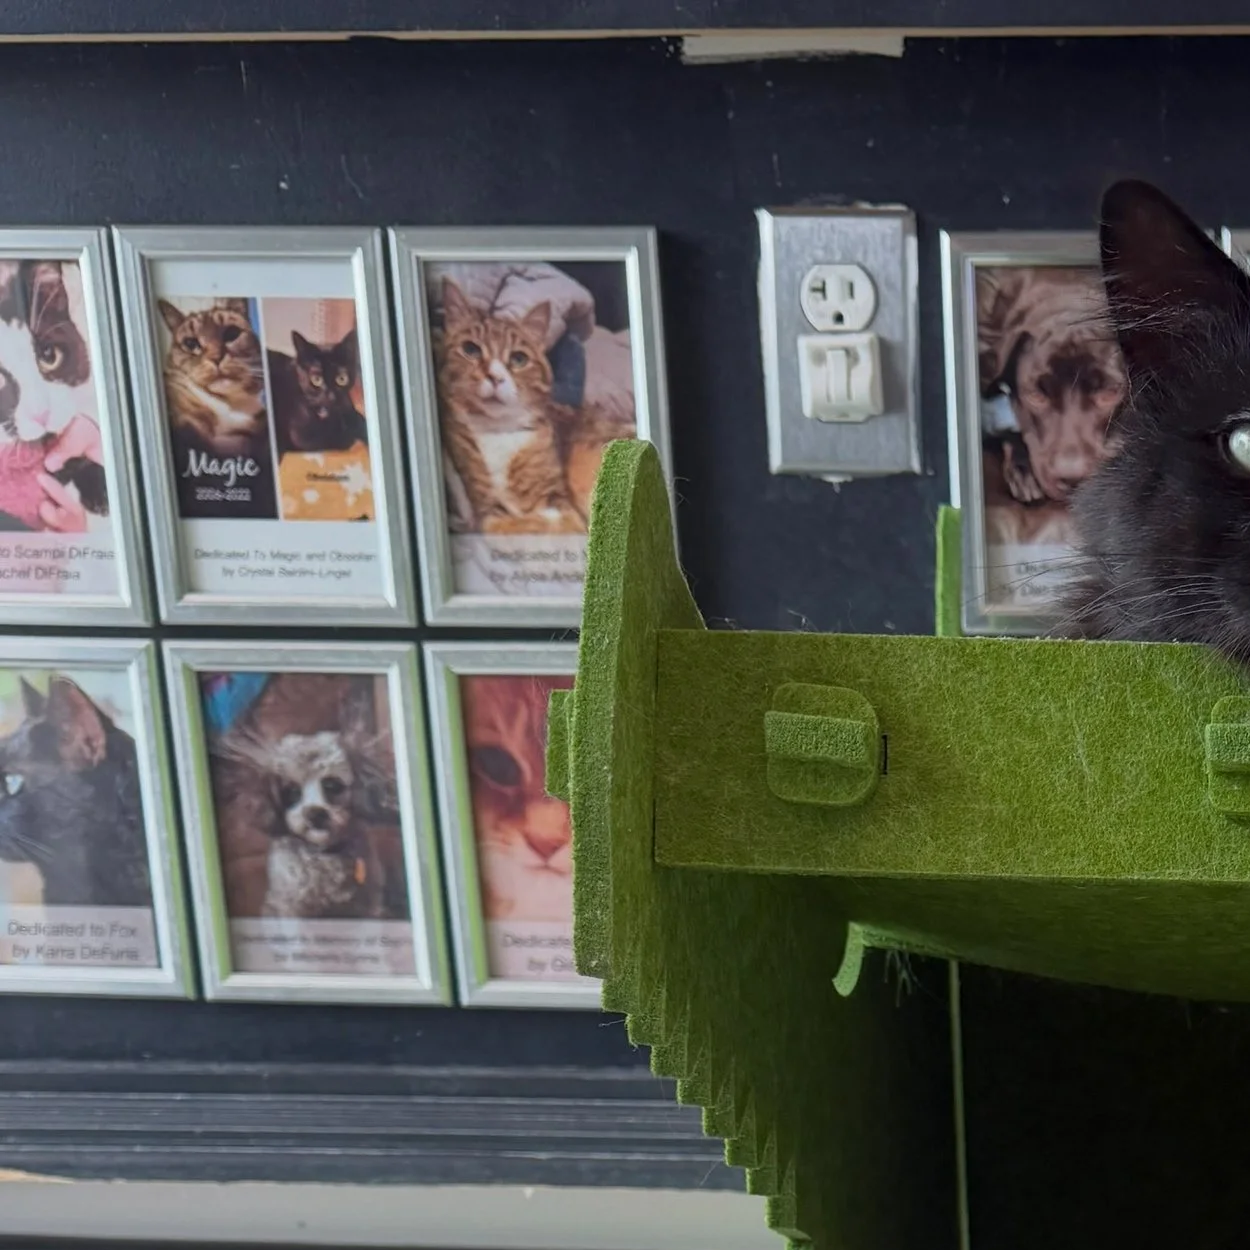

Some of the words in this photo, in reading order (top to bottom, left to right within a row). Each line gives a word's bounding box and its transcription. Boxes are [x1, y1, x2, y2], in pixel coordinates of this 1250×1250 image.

[182, 448, 261, 487] Magic
[8, 920, 85, 937] Dedicated
[90, 921, 105, 938] to
[109, 921, 138, 939] Fox
[502, 931, 575, 948] Dedicate
[12, 944, 30, 960] by
